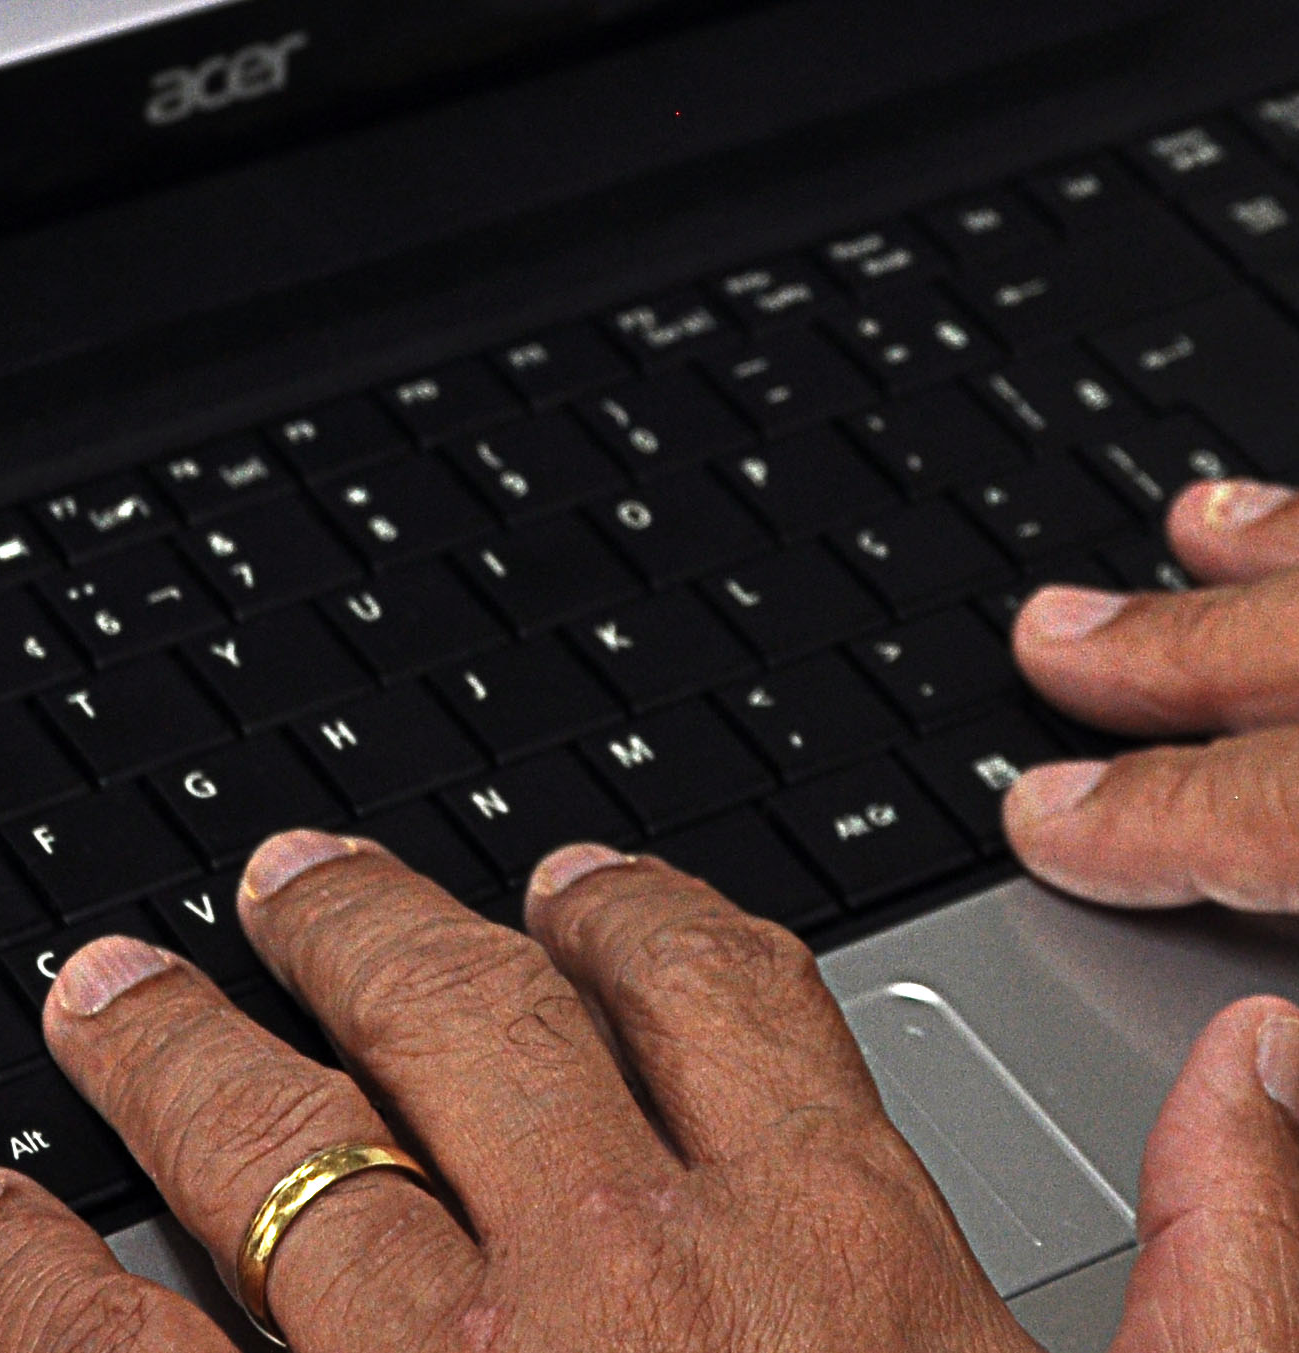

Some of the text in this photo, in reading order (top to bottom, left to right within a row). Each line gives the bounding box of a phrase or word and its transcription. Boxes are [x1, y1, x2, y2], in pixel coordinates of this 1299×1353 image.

[146, 32, 307, 127] acer
[616, 498, 654, 531] O
[346, 591, 384, 623] U
[594, 619, 634, 652] K
[211, 638, 242, 669] Y
[67, 689, 96, 719] T
[319, 717, 359, 751] H
[608, 733, 656, 770] M
[183, 769, 218, 800] G
[470, 786, 511, 820] N
[31, 824, 57, 856] F
[182, 892, 216, 925] V
[9, 1128, 50, 1161] Alt
